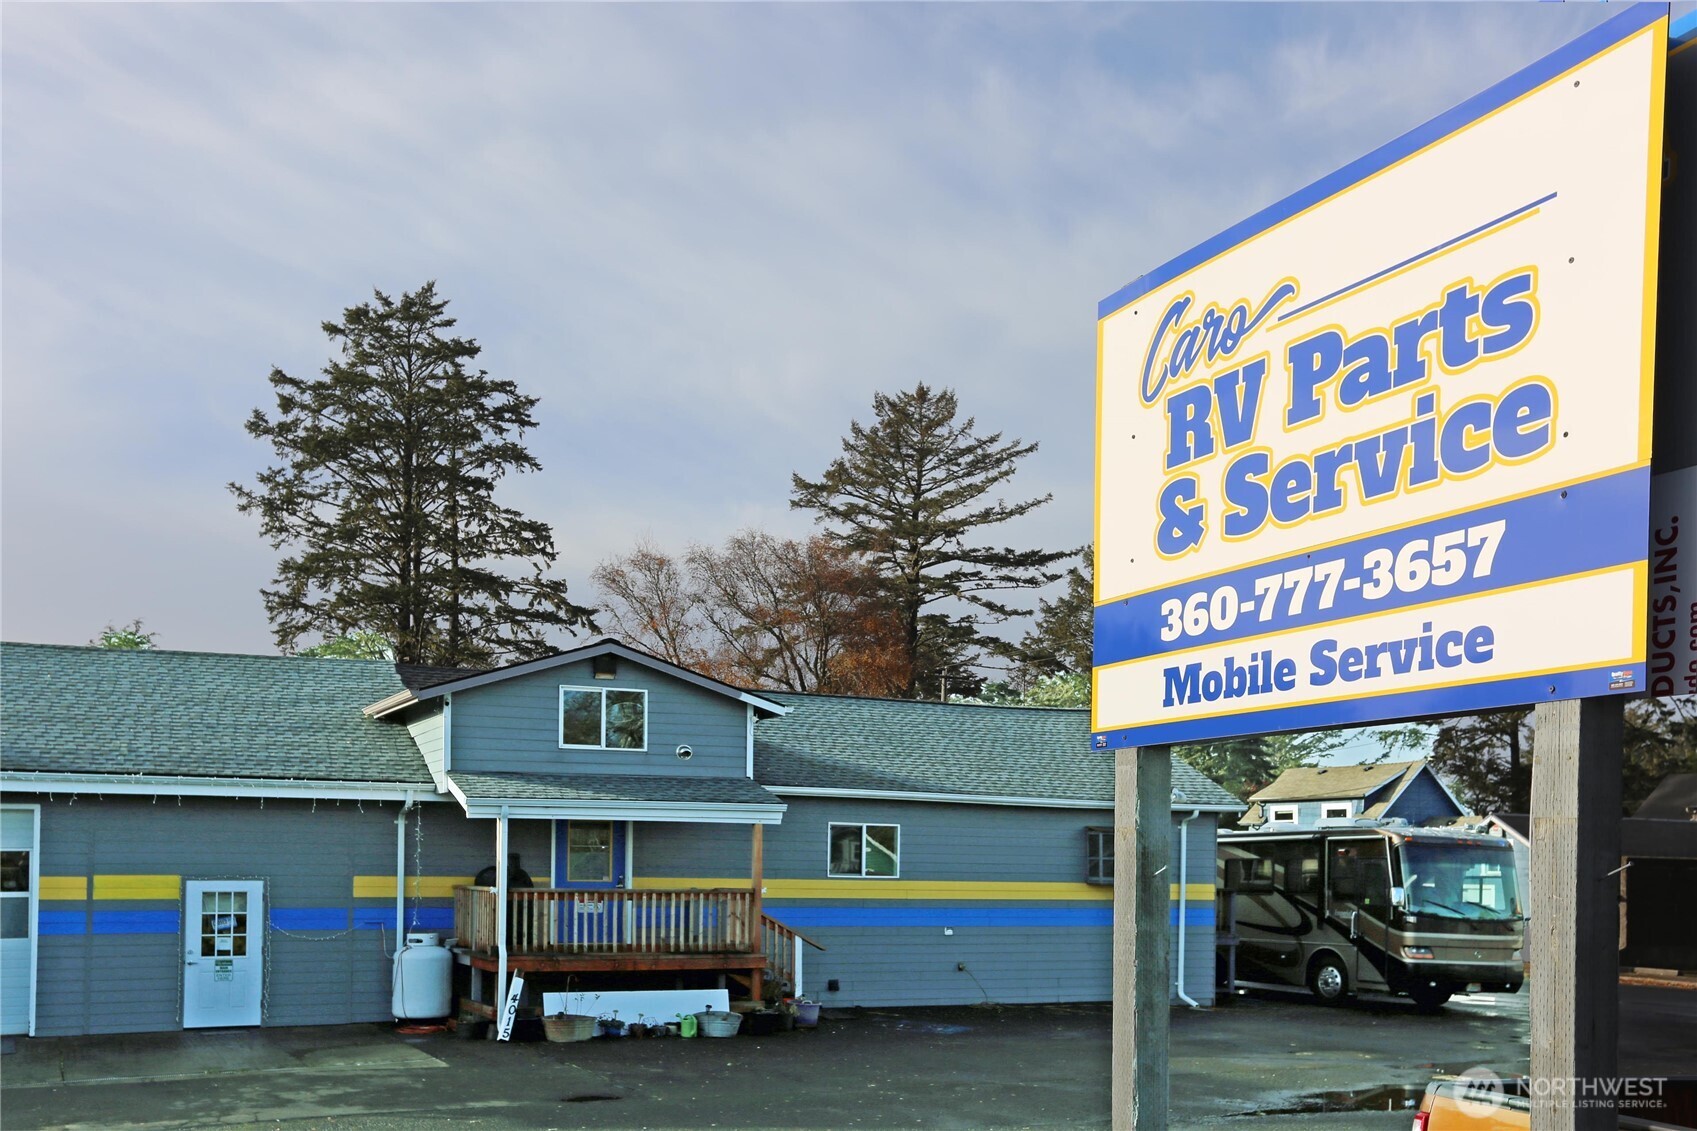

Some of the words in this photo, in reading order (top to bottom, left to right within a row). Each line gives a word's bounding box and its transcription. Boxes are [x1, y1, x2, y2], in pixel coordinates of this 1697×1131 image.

[1143, 284, 1296, 404] Caro
[1165, 358, 1267, 470] RV
[1286, 272, 1533, 427] Parts
[1157, 477, 1205, 555] &
[1224, 383, 1552, 538] Service
[1160, 519, 1507, 642] 360-777-3657
[1162, 649, 1296, 707] Mobile
[1309, 621, 1495, 687] Service
[502, 993, 519, 1039] 4015
